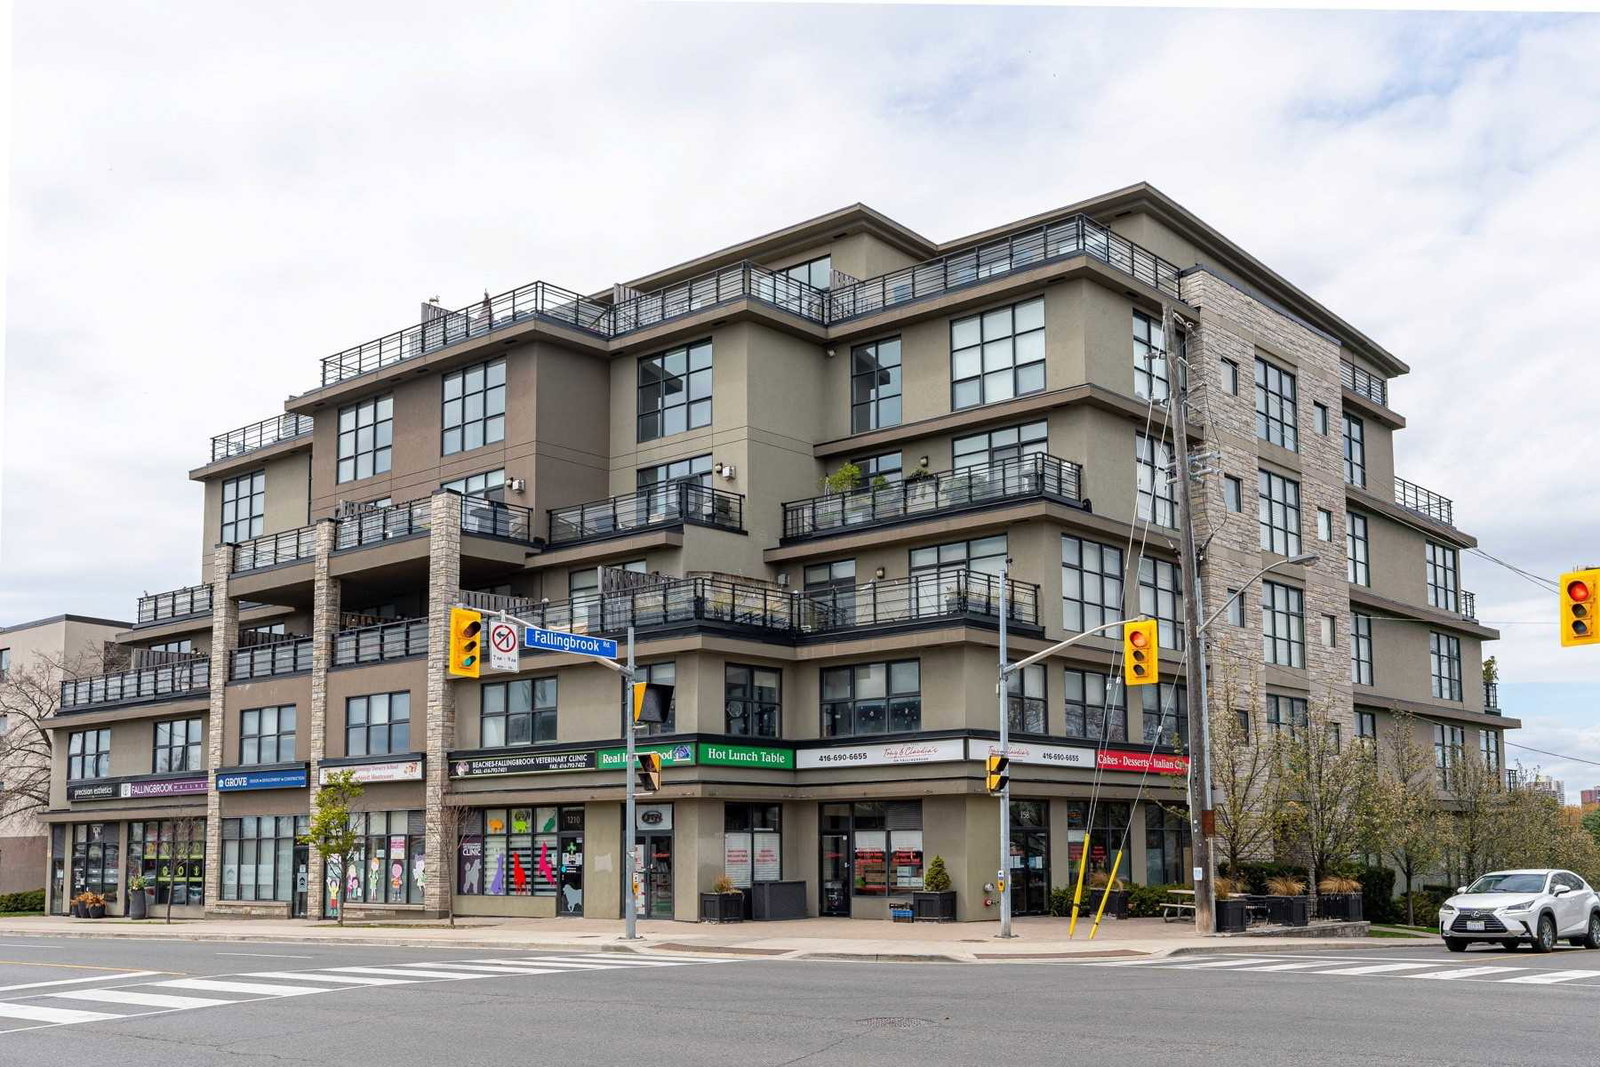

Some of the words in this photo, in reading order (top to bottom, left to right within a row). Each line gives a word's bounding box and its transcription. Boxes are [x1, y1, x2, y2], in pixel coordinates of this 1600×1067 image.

[534, 630, 600, 652] Fallingbrook
[472, 759, 535, 769] BEACHES-FALLINGBROOK
[535, 756, 567, 765] VETERINARY
[568, 753, 588, 762] CLINIC
[602, 753, 620, 763] Real
[708, 748, 726, 760] Hot
[728, 751, 758, 762] Lunch
[760, 751, 785, 763] Table
[818, 752, 868, 762] 416-690-6655
[1042, 752, 1079, 762] 416-690-6655
[1097, 754, 1118, 765] Cakes
[1122, 755, 1149, 767] Desserts
[1153, 758, 1174, 769] Italian
[224, 776, 248, 787] GROVE
[131, 783, 173, 795] FALLINGBROOK
